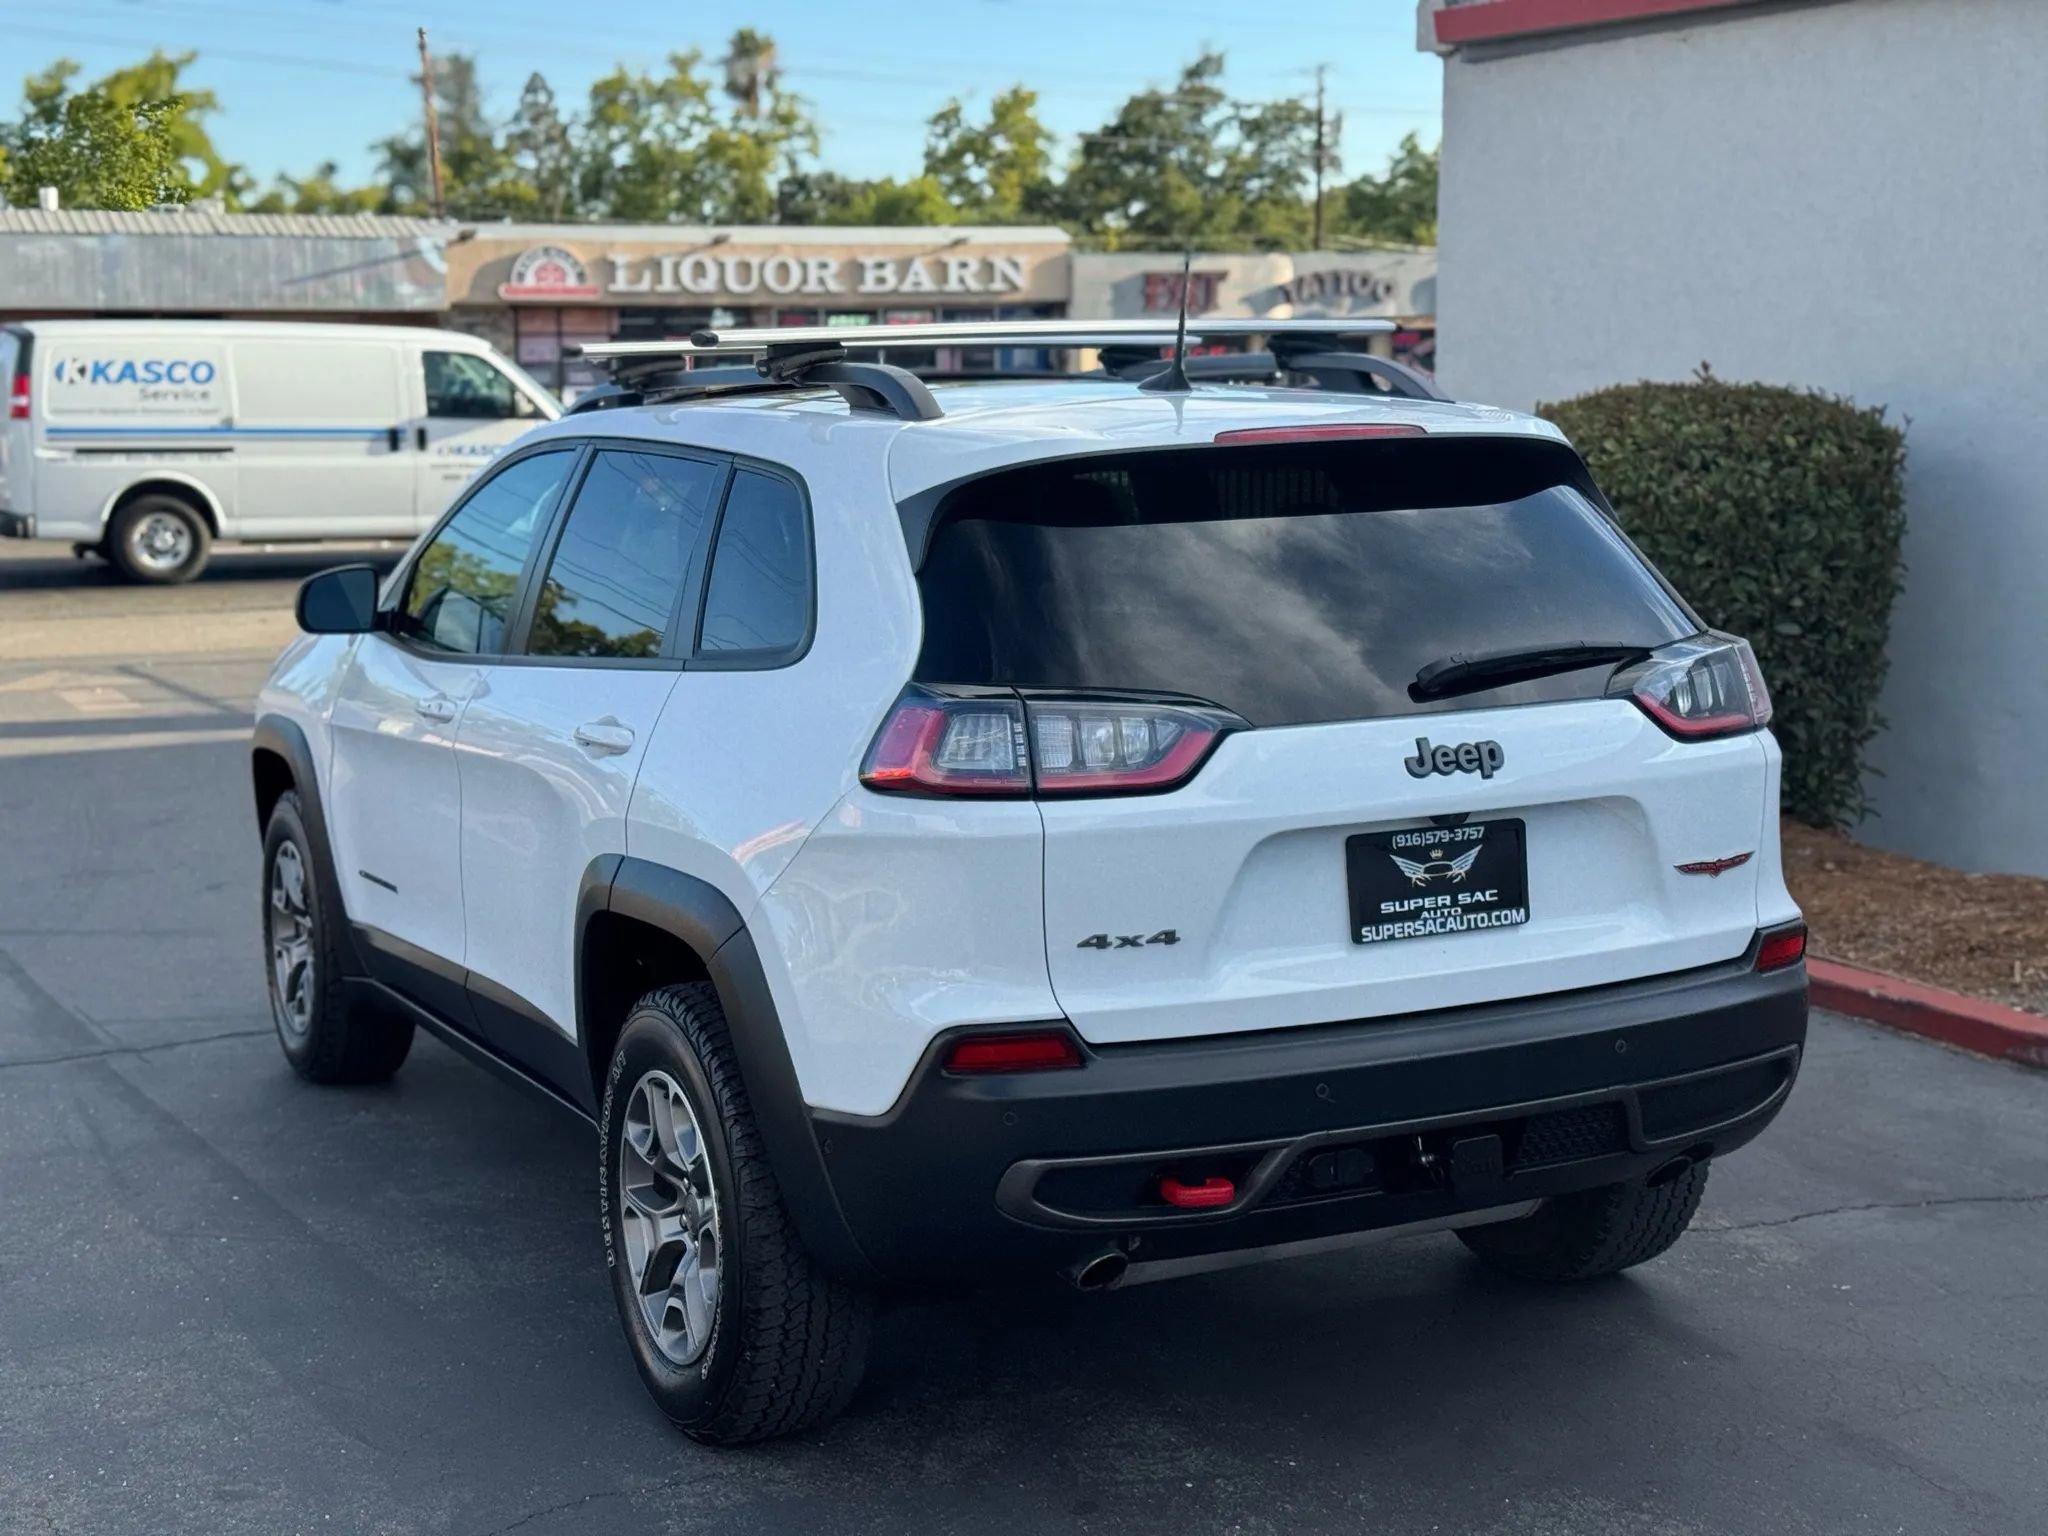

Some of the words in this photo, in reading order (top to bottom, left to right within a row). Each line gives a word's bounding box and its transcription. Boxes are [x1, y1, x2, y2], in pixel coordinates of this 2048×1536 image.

[606, 253, 848, 294] LIQUOR
[857, 254, 1033, 293] BARN
[91, 360, 216, 385] KASCO
[139, 388, 211, 401] Service
[1404, 736, 1505, 780] Jeep
[1392, 825, 1486, 850] (916)579-3757
[1379, 894, 1452, 915] SUPER
[1457, 888, 1499, 904] SAC
[1420, 906, 1463, 920] AUTO
[1361, 907, 1527, 943] SUPERSACAUTO.COM
[1076, 928, 1182, 950] 4x4
